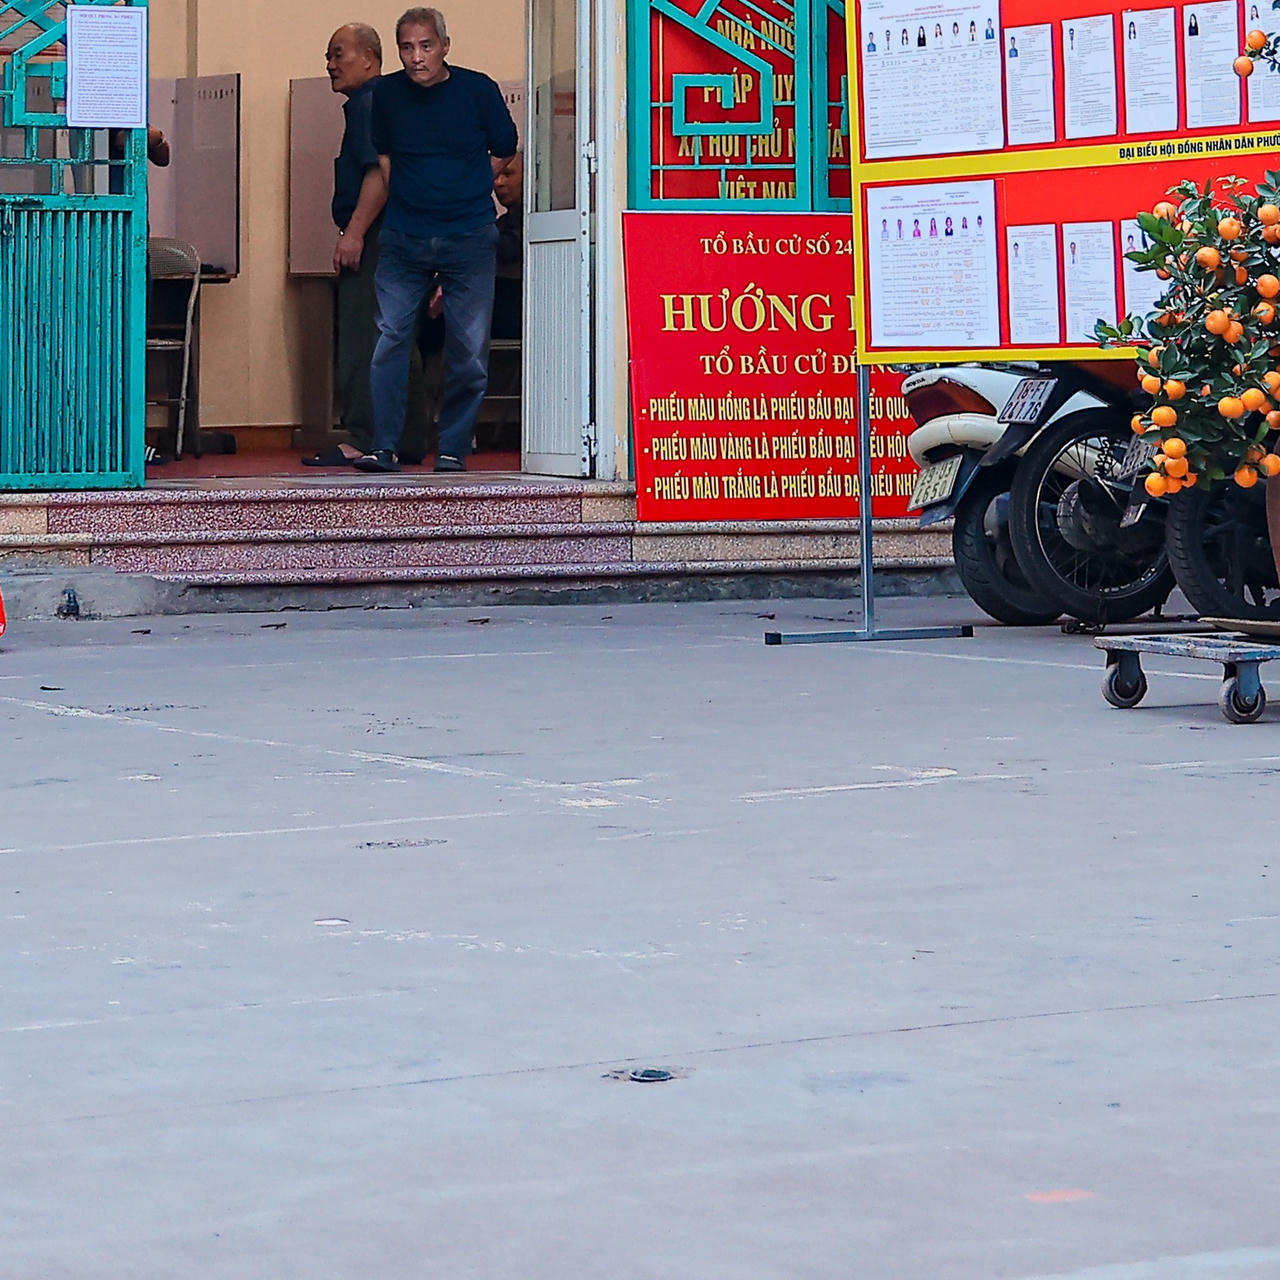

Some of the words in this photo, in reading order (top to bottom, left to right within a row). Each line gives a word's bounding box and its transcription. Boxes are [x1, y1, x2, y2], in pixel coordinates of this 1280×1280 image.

[1119, 147, 1135, 161] ĐẠI
[1137, 141, 1158, 157] BIỂU
[1160, 143, 1176, 158] HỘI
[1206, 136, 1232, 152] NHÂN
[1234, 135, 1254, 150] DÂN
[700, 230, 728, 254] TỔ
[732, 231, 770, 255] BẦU
[775, 233, 802, 255] CỬ
[806, 231, 831, 255] SỐ
[660, 282, 835, 333] HƯỚNG
[699, 345, 734, 375] TỔ
[739, 345, 788, 375] BẦU
[793, 347, 827, 375] CỬ
[649, 391, 685, 421] PHIẾU
[687, 393, 715, 421] MÀU
[718, 390, 751, 421] HỒNG
[753, 393, 768, 420] LÀ
[771, 390, 805, 420] PHIẾU
[808, 389, 832, 420] BẦU
[834, 397, 854, 424] ĐẠI
[652, 430, 687, 460] PHIẾU
[690, 432, 717, 460] MÀU
[720, 431, 752, 460] VÀNG
[754, 431, 770, 459] LÀ
[772, 429, 807, 459] PHIẾU
[810, 428, 833, 458] BẦU
[835, 436, 855, 463] ĐẠI
[888, 431, 907, 463] HỘI
[654, 469, 689, 500] PHIẾU
[692, 472, 719, 500] MÀU
[722, 467, 761, 499] TRẮNG
[763, 470, 779, 498] LÀ
[781, 468, 815, 498] PHIẾU
[818, 467, 842, 497] BẦU
[844, 474, 860, 502] ĐẠ
